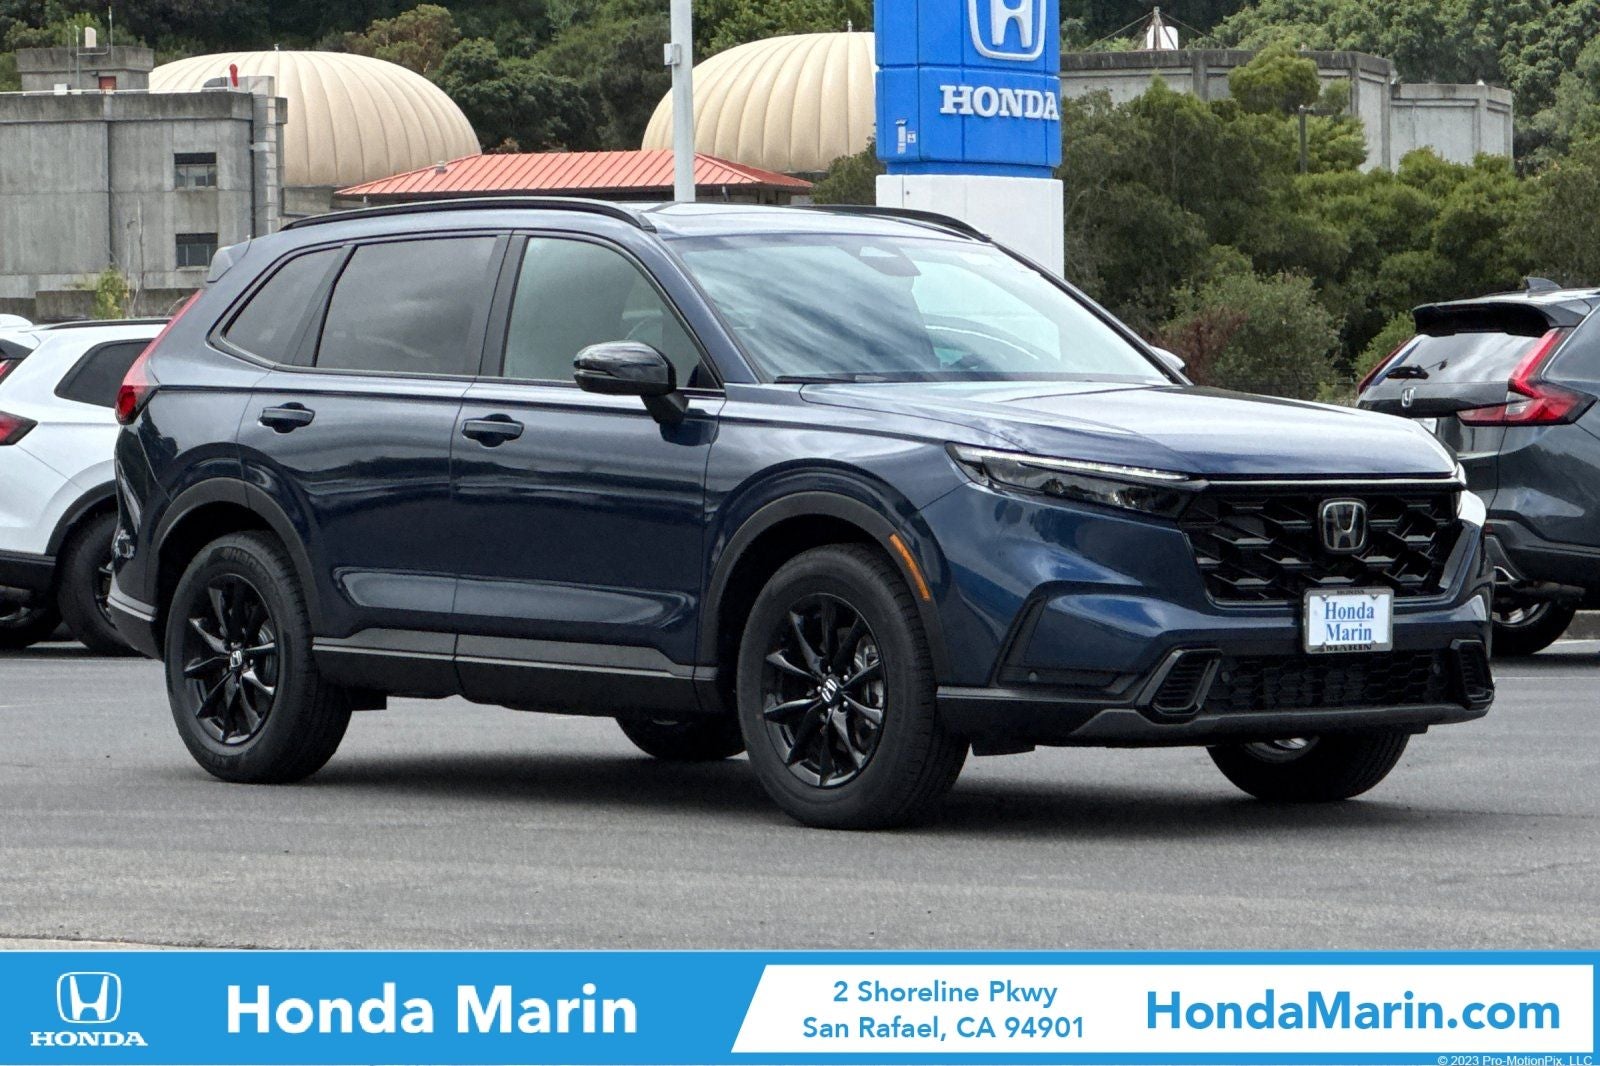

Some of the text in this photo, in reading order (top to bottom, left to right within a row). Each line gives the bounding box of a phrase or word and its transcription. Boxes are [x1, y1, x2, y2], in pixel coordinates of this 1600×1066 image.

[939, 85, 1060, 121] HONDA
[1325, 602, 1375, 620] Honda
[1326, 623, 1372, 642] Marin
[1326, 643, 1372, 652] MARIN
